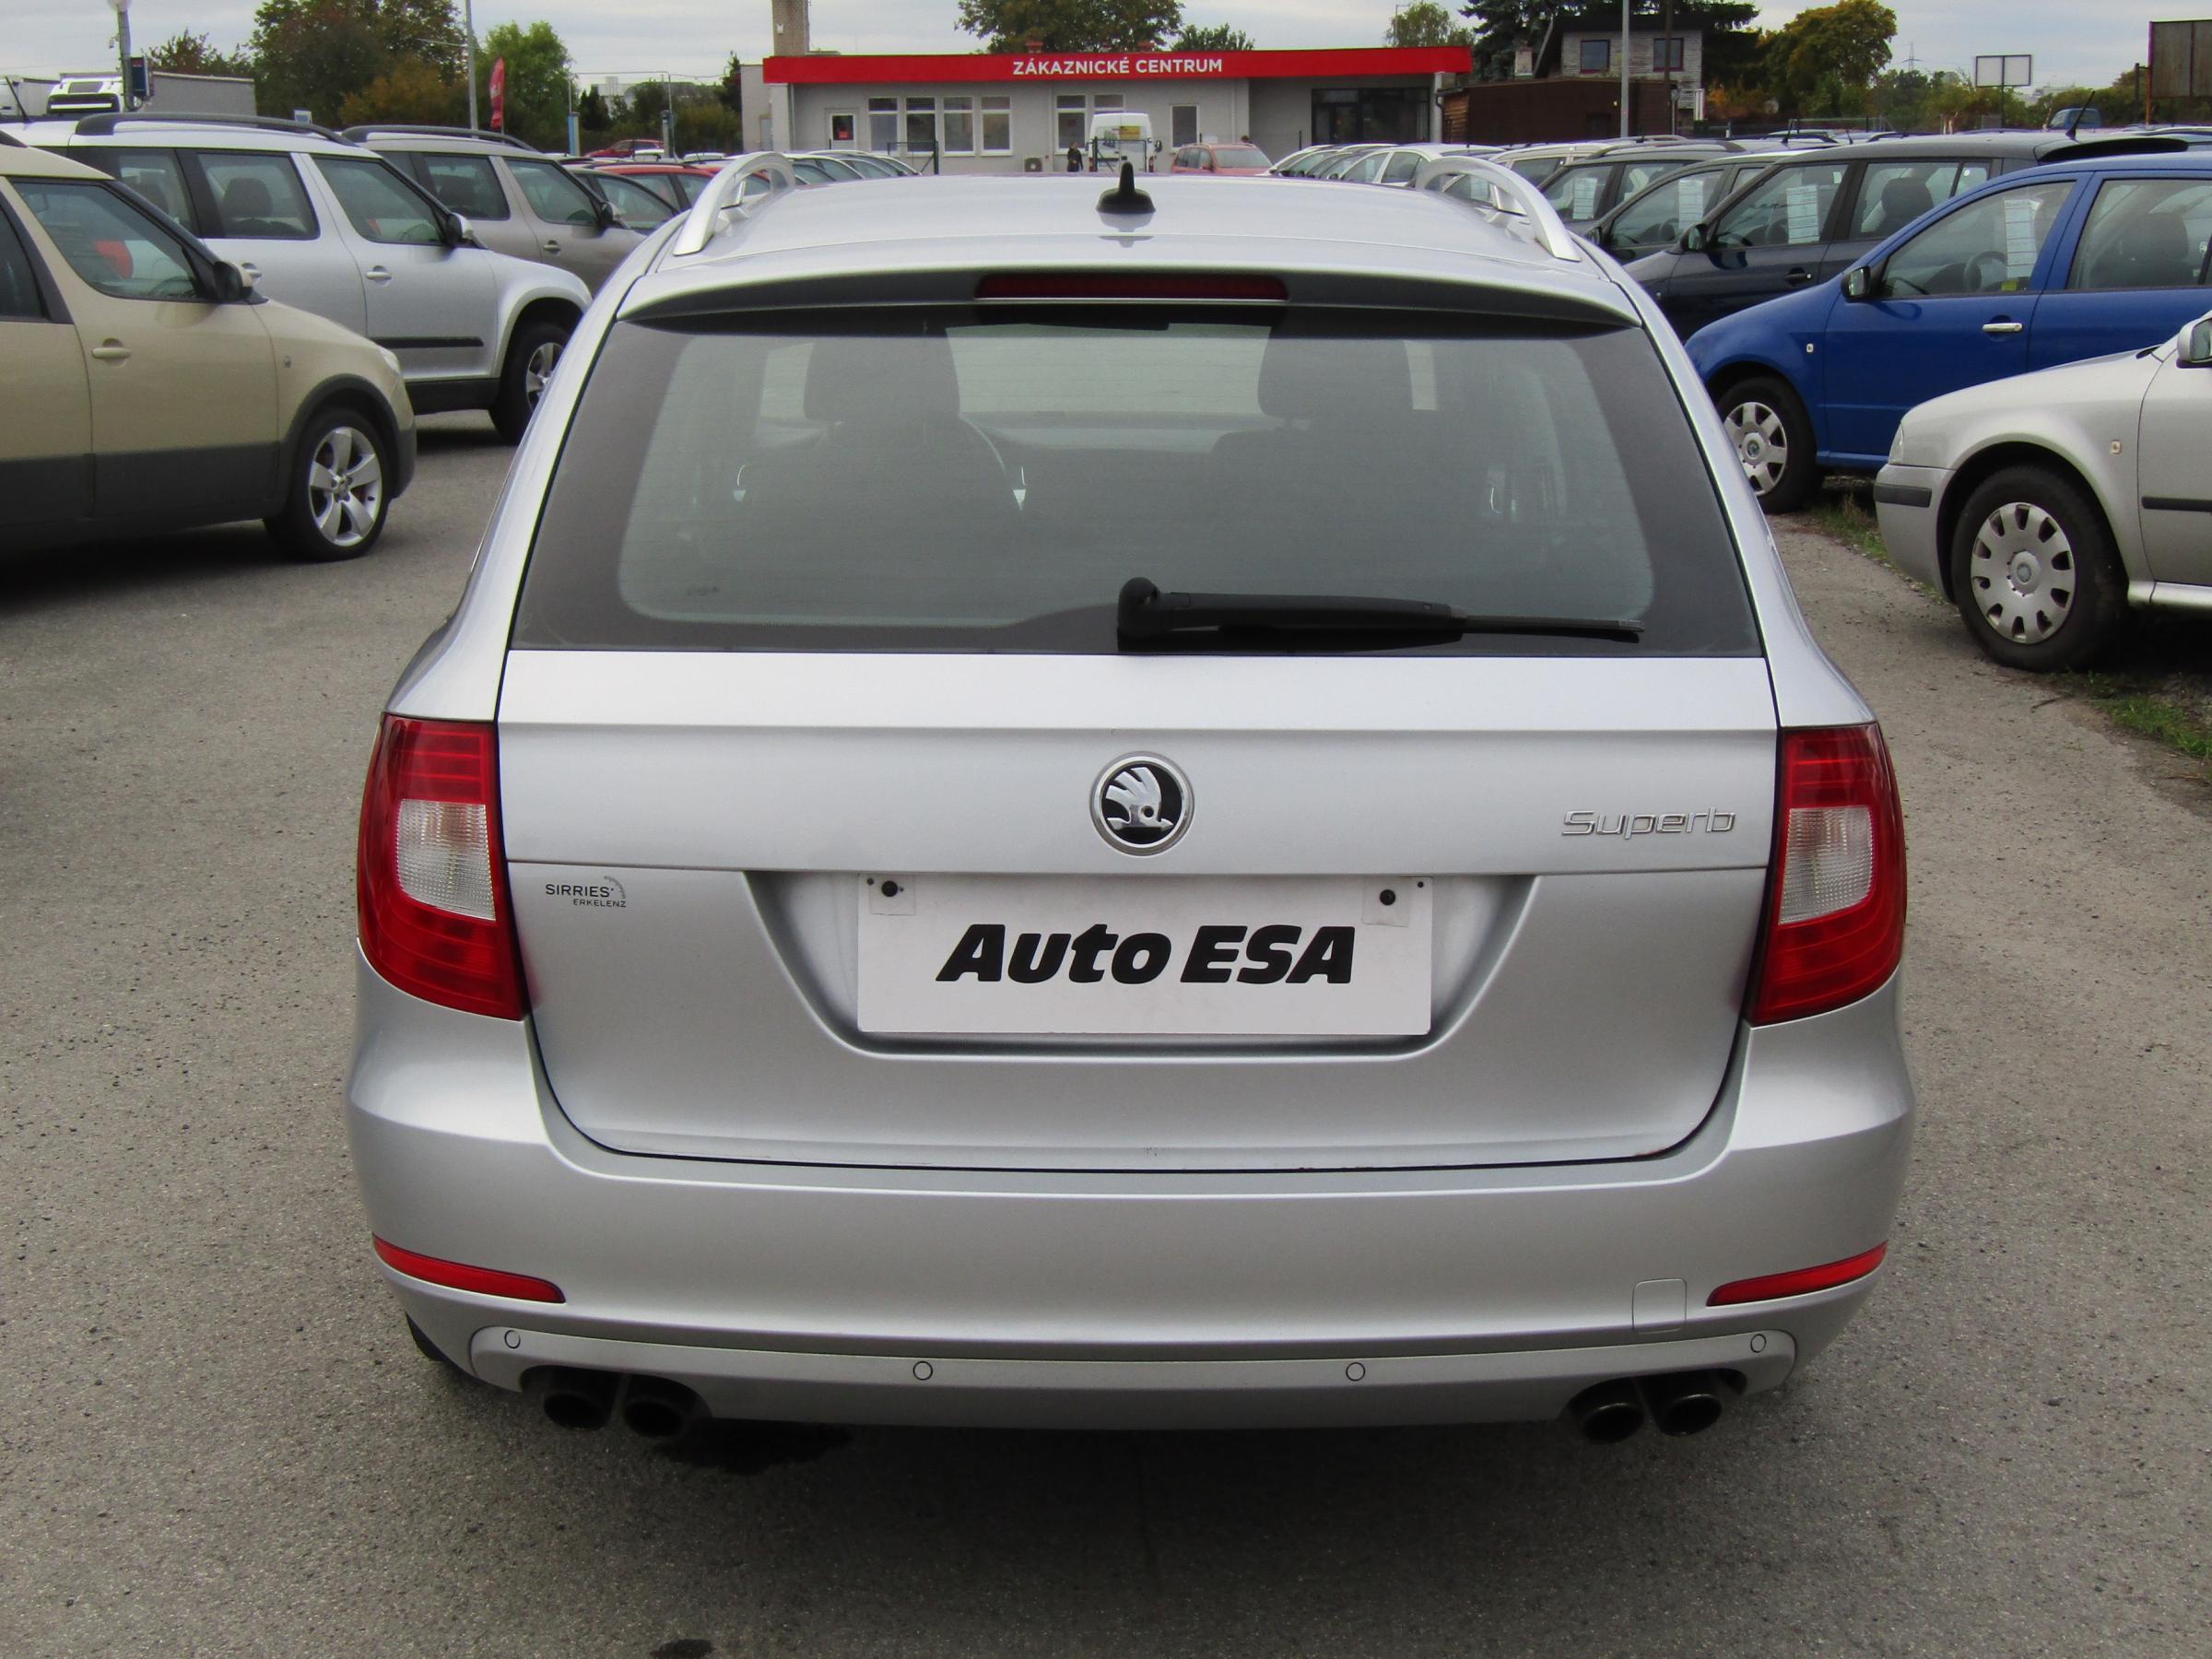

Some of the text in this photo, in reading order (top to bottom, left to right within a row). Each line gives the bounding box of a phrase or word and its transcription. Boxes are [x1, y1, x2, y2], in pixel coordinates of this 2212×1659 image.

[1013, 57, 1223, 76] ZÁKAZNICKÉ CENTRUM
[1561, 806, 1735, 841] Superb
[572, 898, 627, 908] ERKELENZ
[935, 924, 1356, 984] Auto ESA
